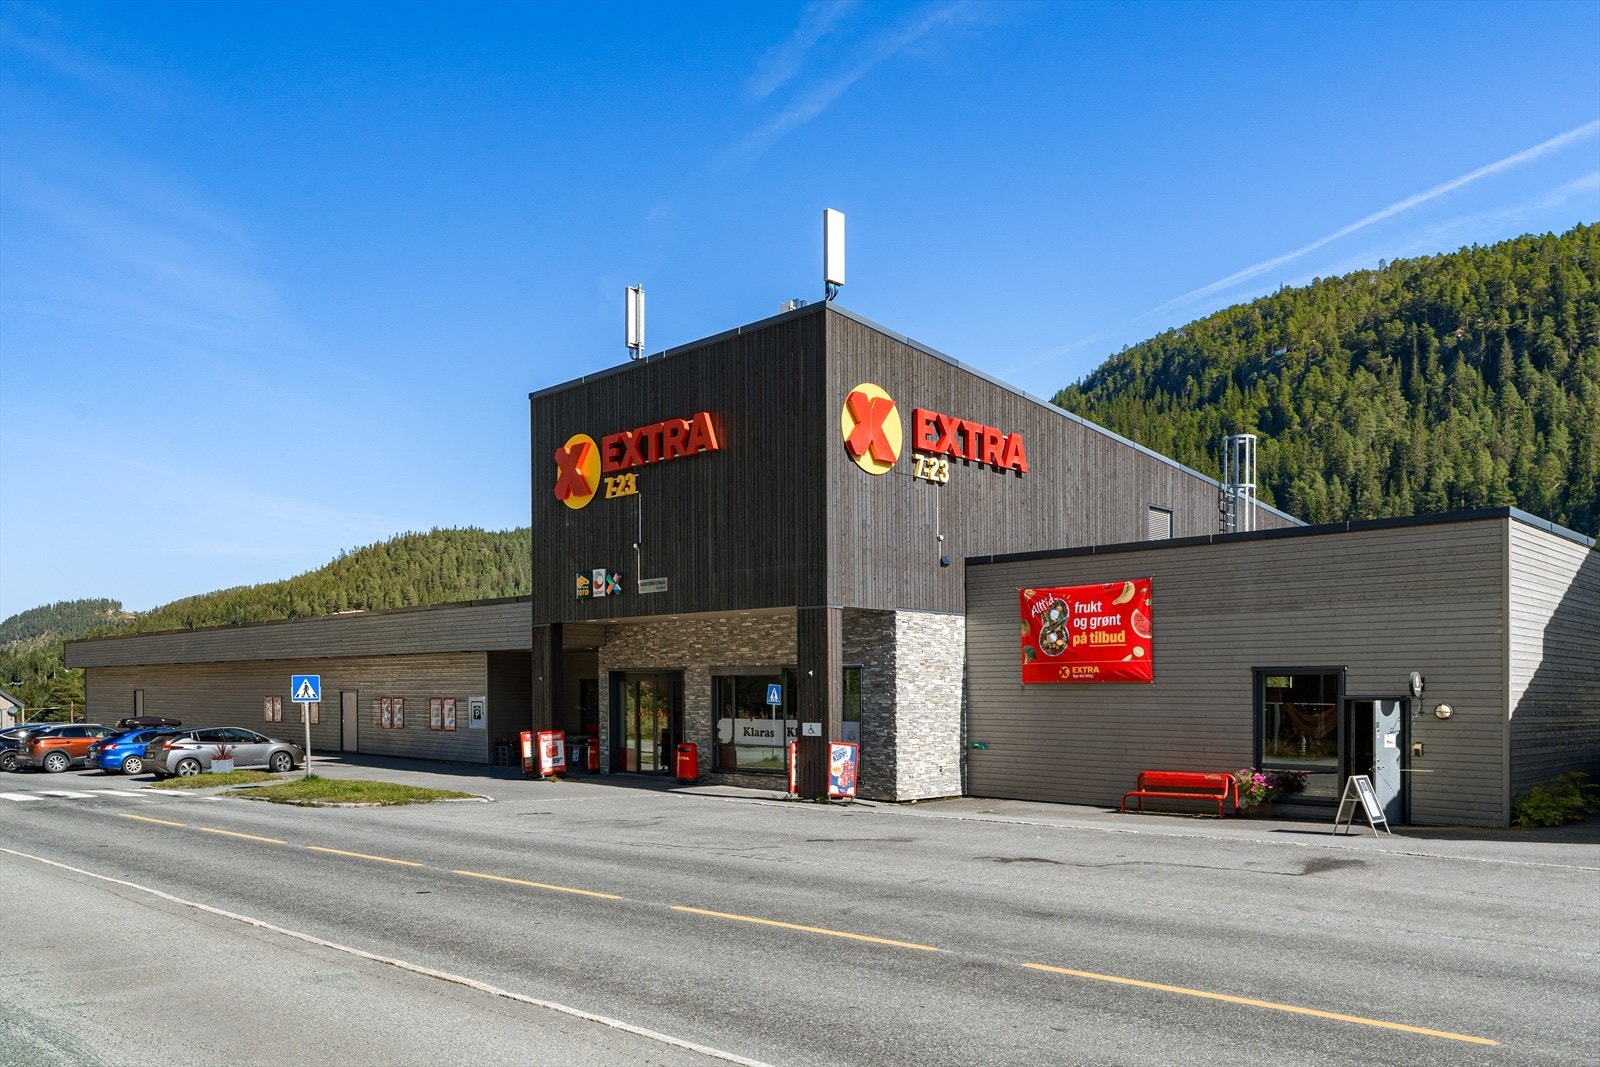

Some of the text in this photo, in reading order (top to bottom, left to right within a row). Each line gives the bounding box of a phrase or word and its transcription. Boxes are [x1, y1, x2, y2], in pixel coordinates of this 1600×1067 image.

[846, 391, 1029, 473] X EXTRA
[554, 412, 719, 500] X EXTRA
[913, 454, 950, 484] 7-23
[604, 473, 638, 499] 7-23
[1031, 593, 1055, 618] Alltid
[1074, 601, 1102, 614] frukt
[1073, 613, 1122, 630] og grønt
[1072, 630, 1126, 647] på tilbud
[1072, 666, 1100, 674] EXTRA
[743, 726, 775, 738] Klaras
